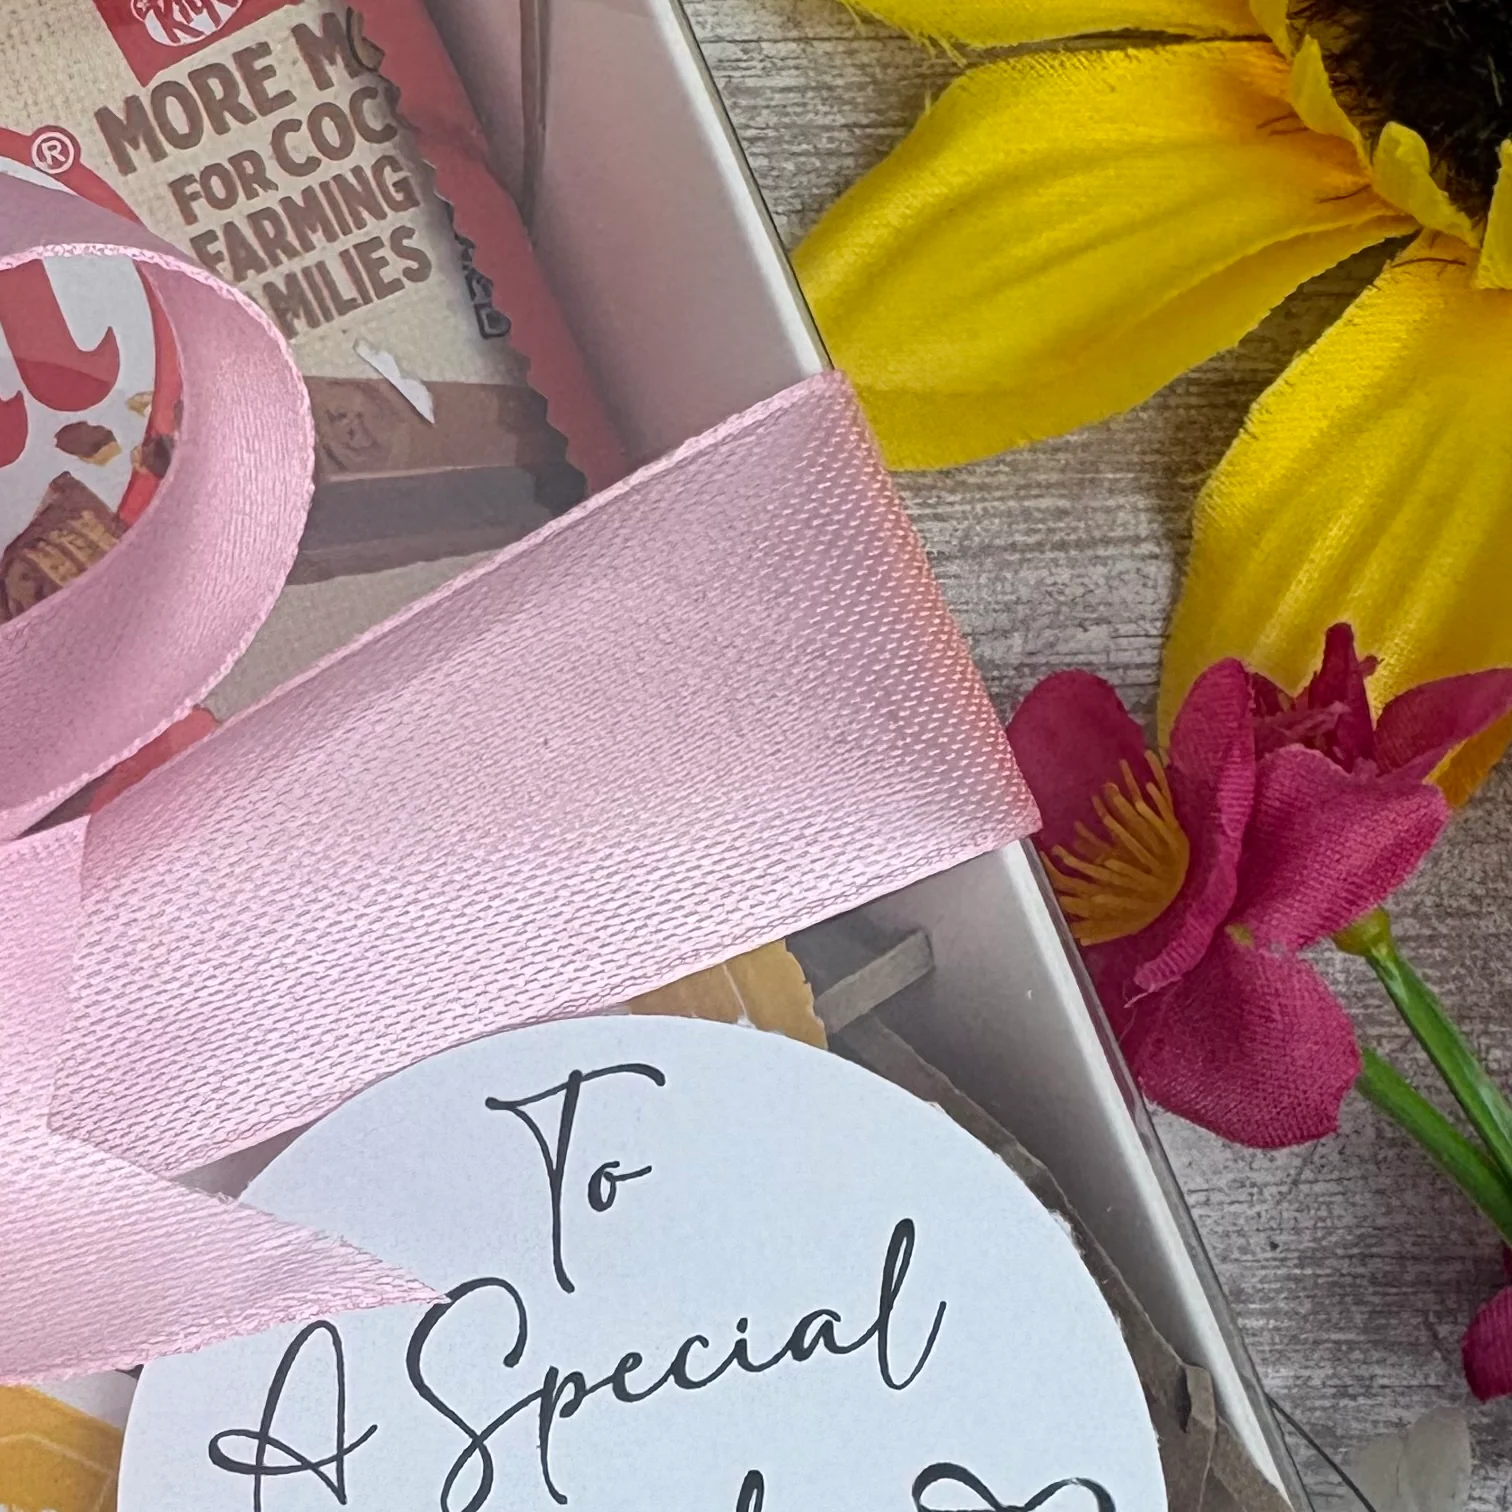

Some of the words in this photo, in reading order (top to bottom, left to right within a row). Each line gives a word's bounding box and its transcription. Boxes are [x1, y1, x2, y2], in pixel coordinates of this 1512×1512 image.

[94, 41, 297, 176] MORE
[169, 150, 279, 226] FOR
[270, 86, 399, 177] COC
[190, 155, 420, 283] FARMING
[246, 225, 432, 340] MILIES
[485, 1064, 665, 1293] To
